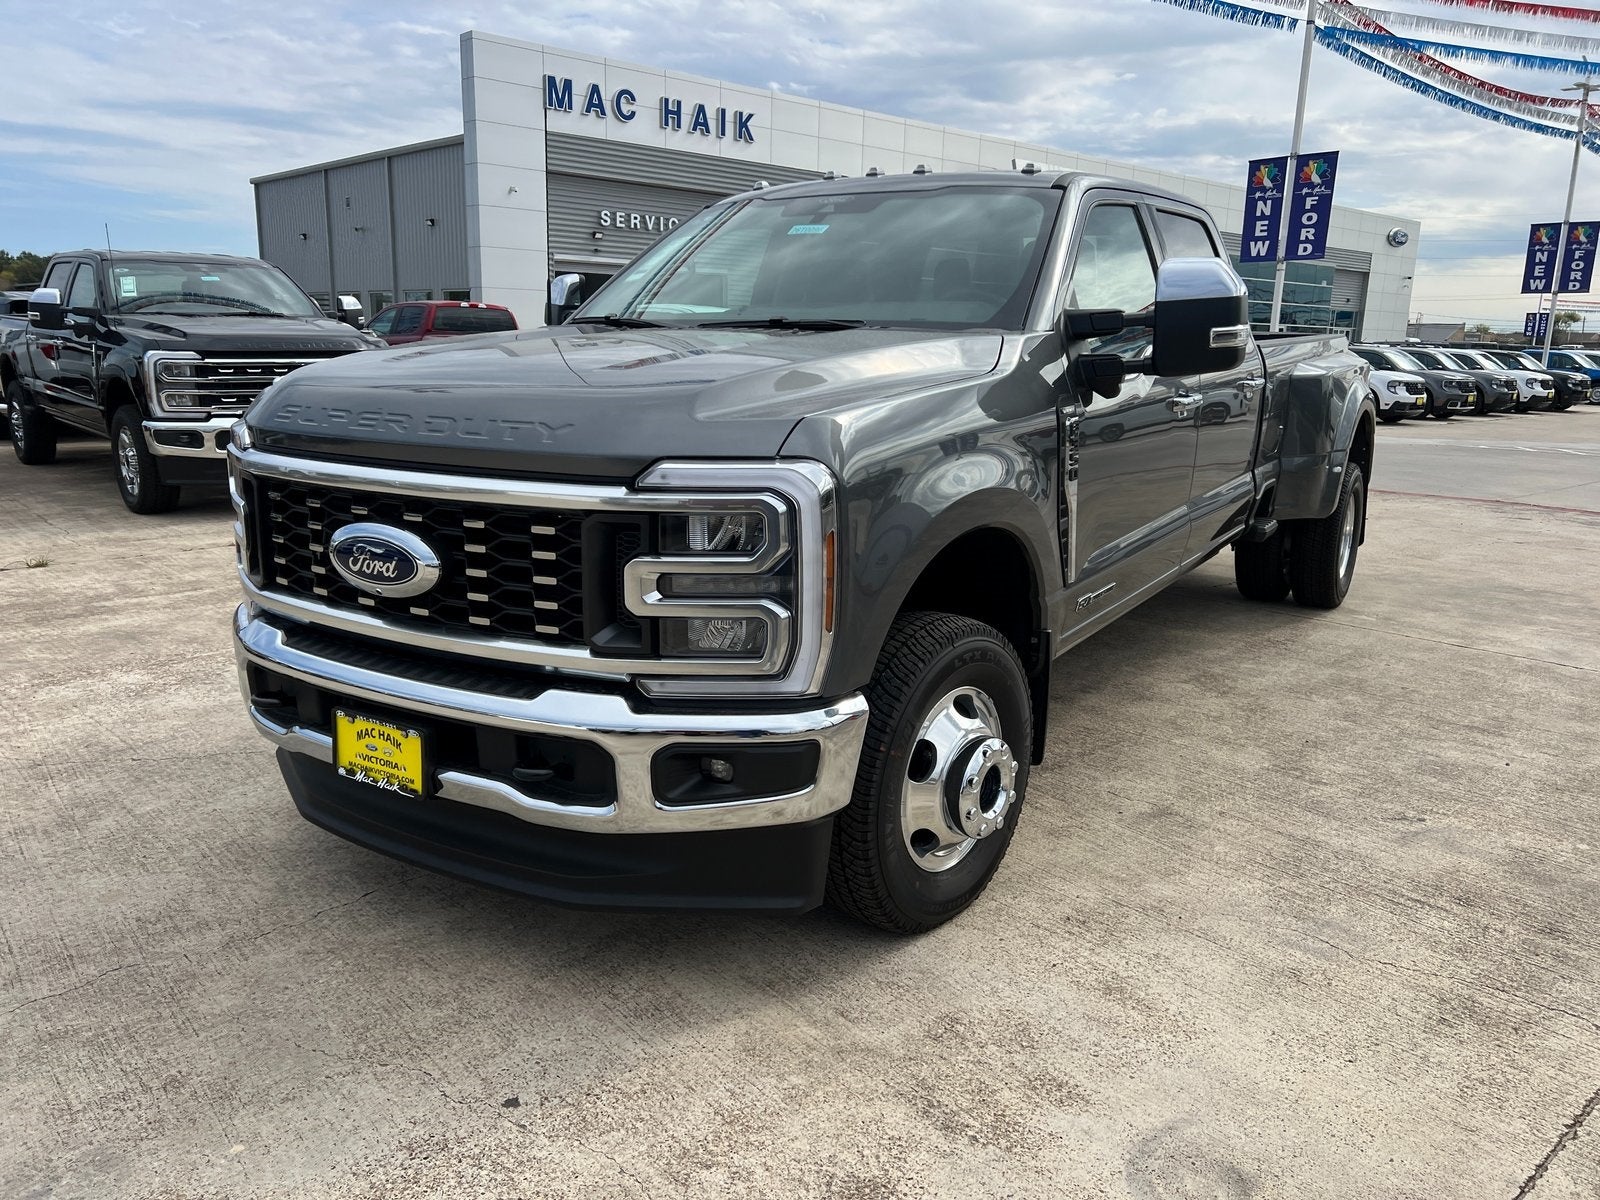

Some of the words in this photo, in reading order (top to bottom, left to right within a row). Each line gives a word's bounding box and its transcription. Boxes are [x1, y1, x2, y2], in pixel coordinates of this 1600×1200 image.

[543, 73, 637, 122] MAC
[659, 95, 756, 143] HAIK
[1249, 200, 1272, 257] NEW
[1297, 196, 1319, 256] FORD
[1529, 251, 1548, 290] NEW
[1568, 250, 1585, 290] FORD
[273, 403, 413, 433] SUPER
[417, 414, 576, 443] DUTY
[349, 543, 399, 578] Ford
[356, 728, 376, 742] MAC
[378, 729, 402, 753] HAIK
[361, 753, 400, 771] VICTORIA
[353, 769, 376, 786] Mac
[377, 778, 408, 795] Haik
